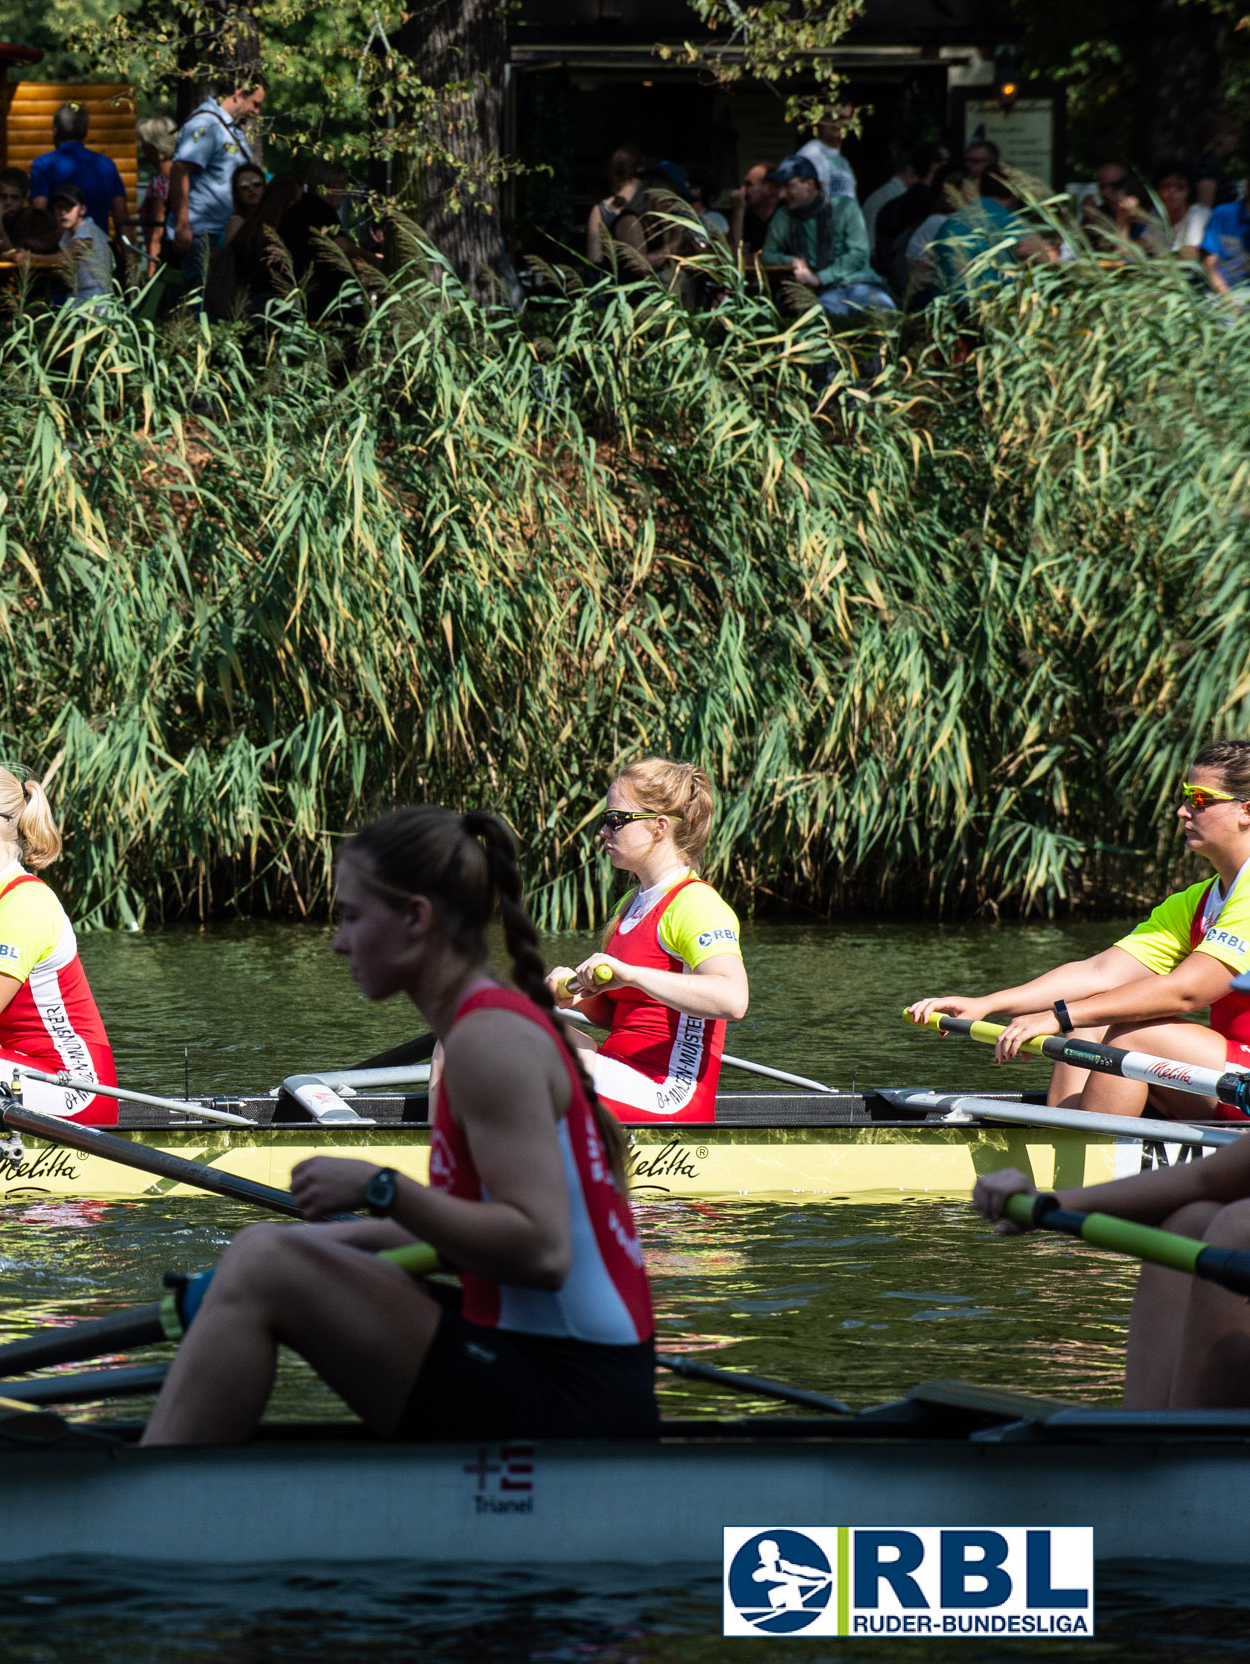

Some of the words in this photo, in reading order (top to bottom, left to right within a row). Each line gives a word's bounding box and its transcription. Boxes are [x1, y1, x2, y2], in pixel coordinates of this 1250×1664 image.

[713, 929, 738, 942] RBL
[1217, 931, 1246, 953] RBL
[1144, 1061, 1194, 1086] Melitta
[475, 1495, 534, 1514] Trianel
